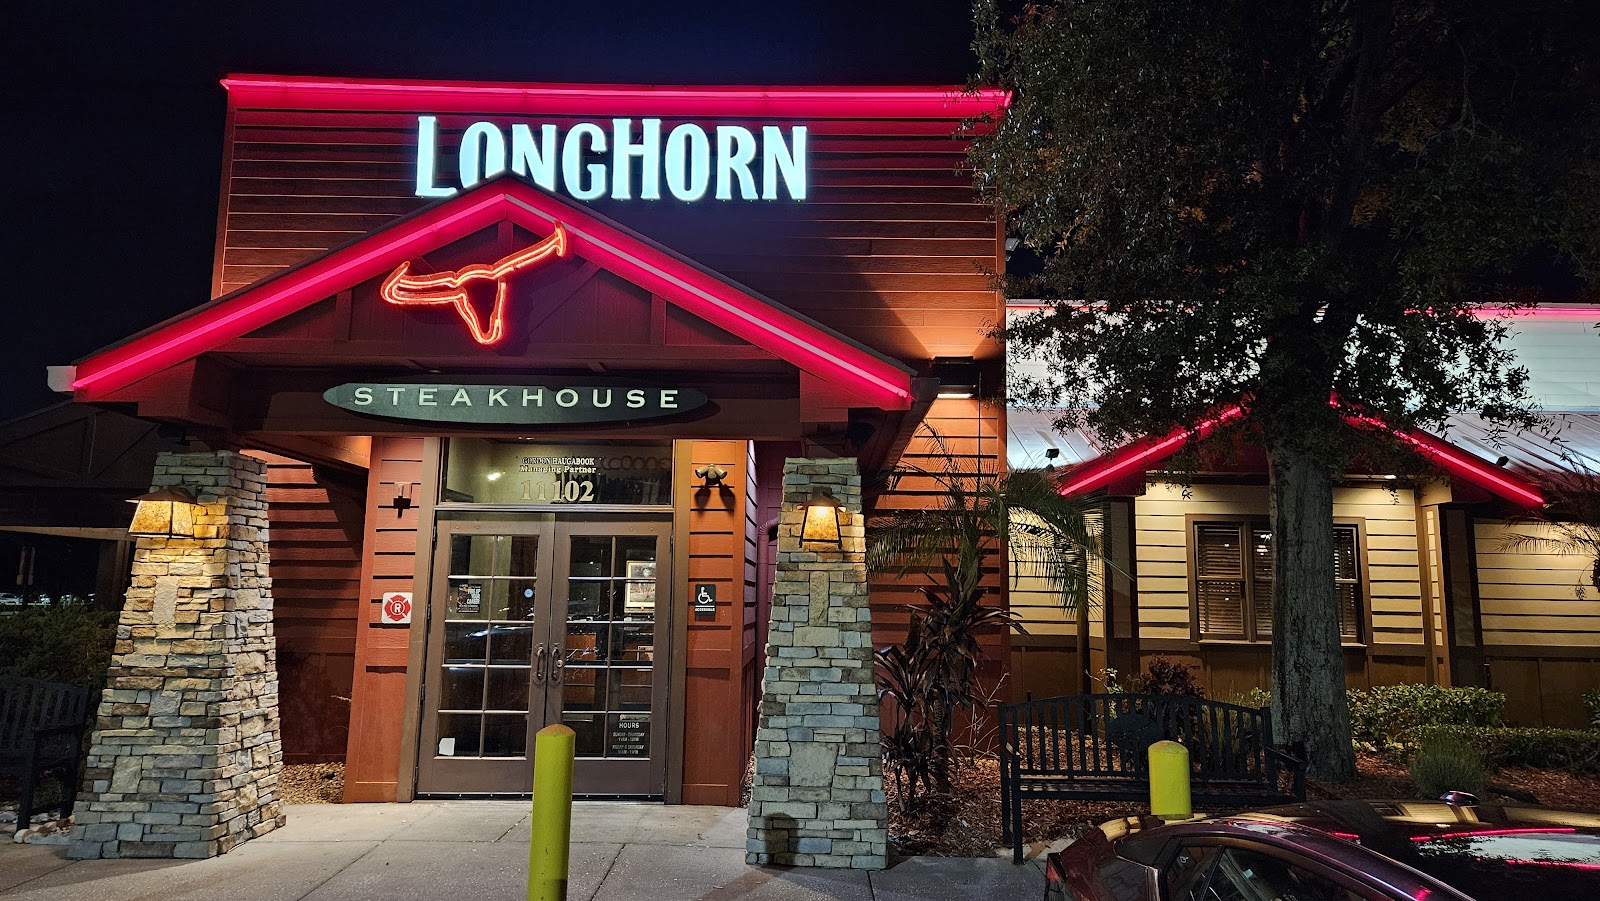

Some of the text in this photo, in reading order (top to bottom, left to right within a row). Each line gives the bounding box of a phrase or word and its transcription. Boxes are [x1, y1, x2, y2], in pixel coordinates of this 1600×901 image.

[415, 116, 807, 200] LONGHORN
[353, 387, 678, 409] STEAKHOUSE
[519, 465, 597, 474] Managing Partner
[522, 457, 595, 466] GORDON HAUGABOOK
[521, 480, 595, 502] 11102
